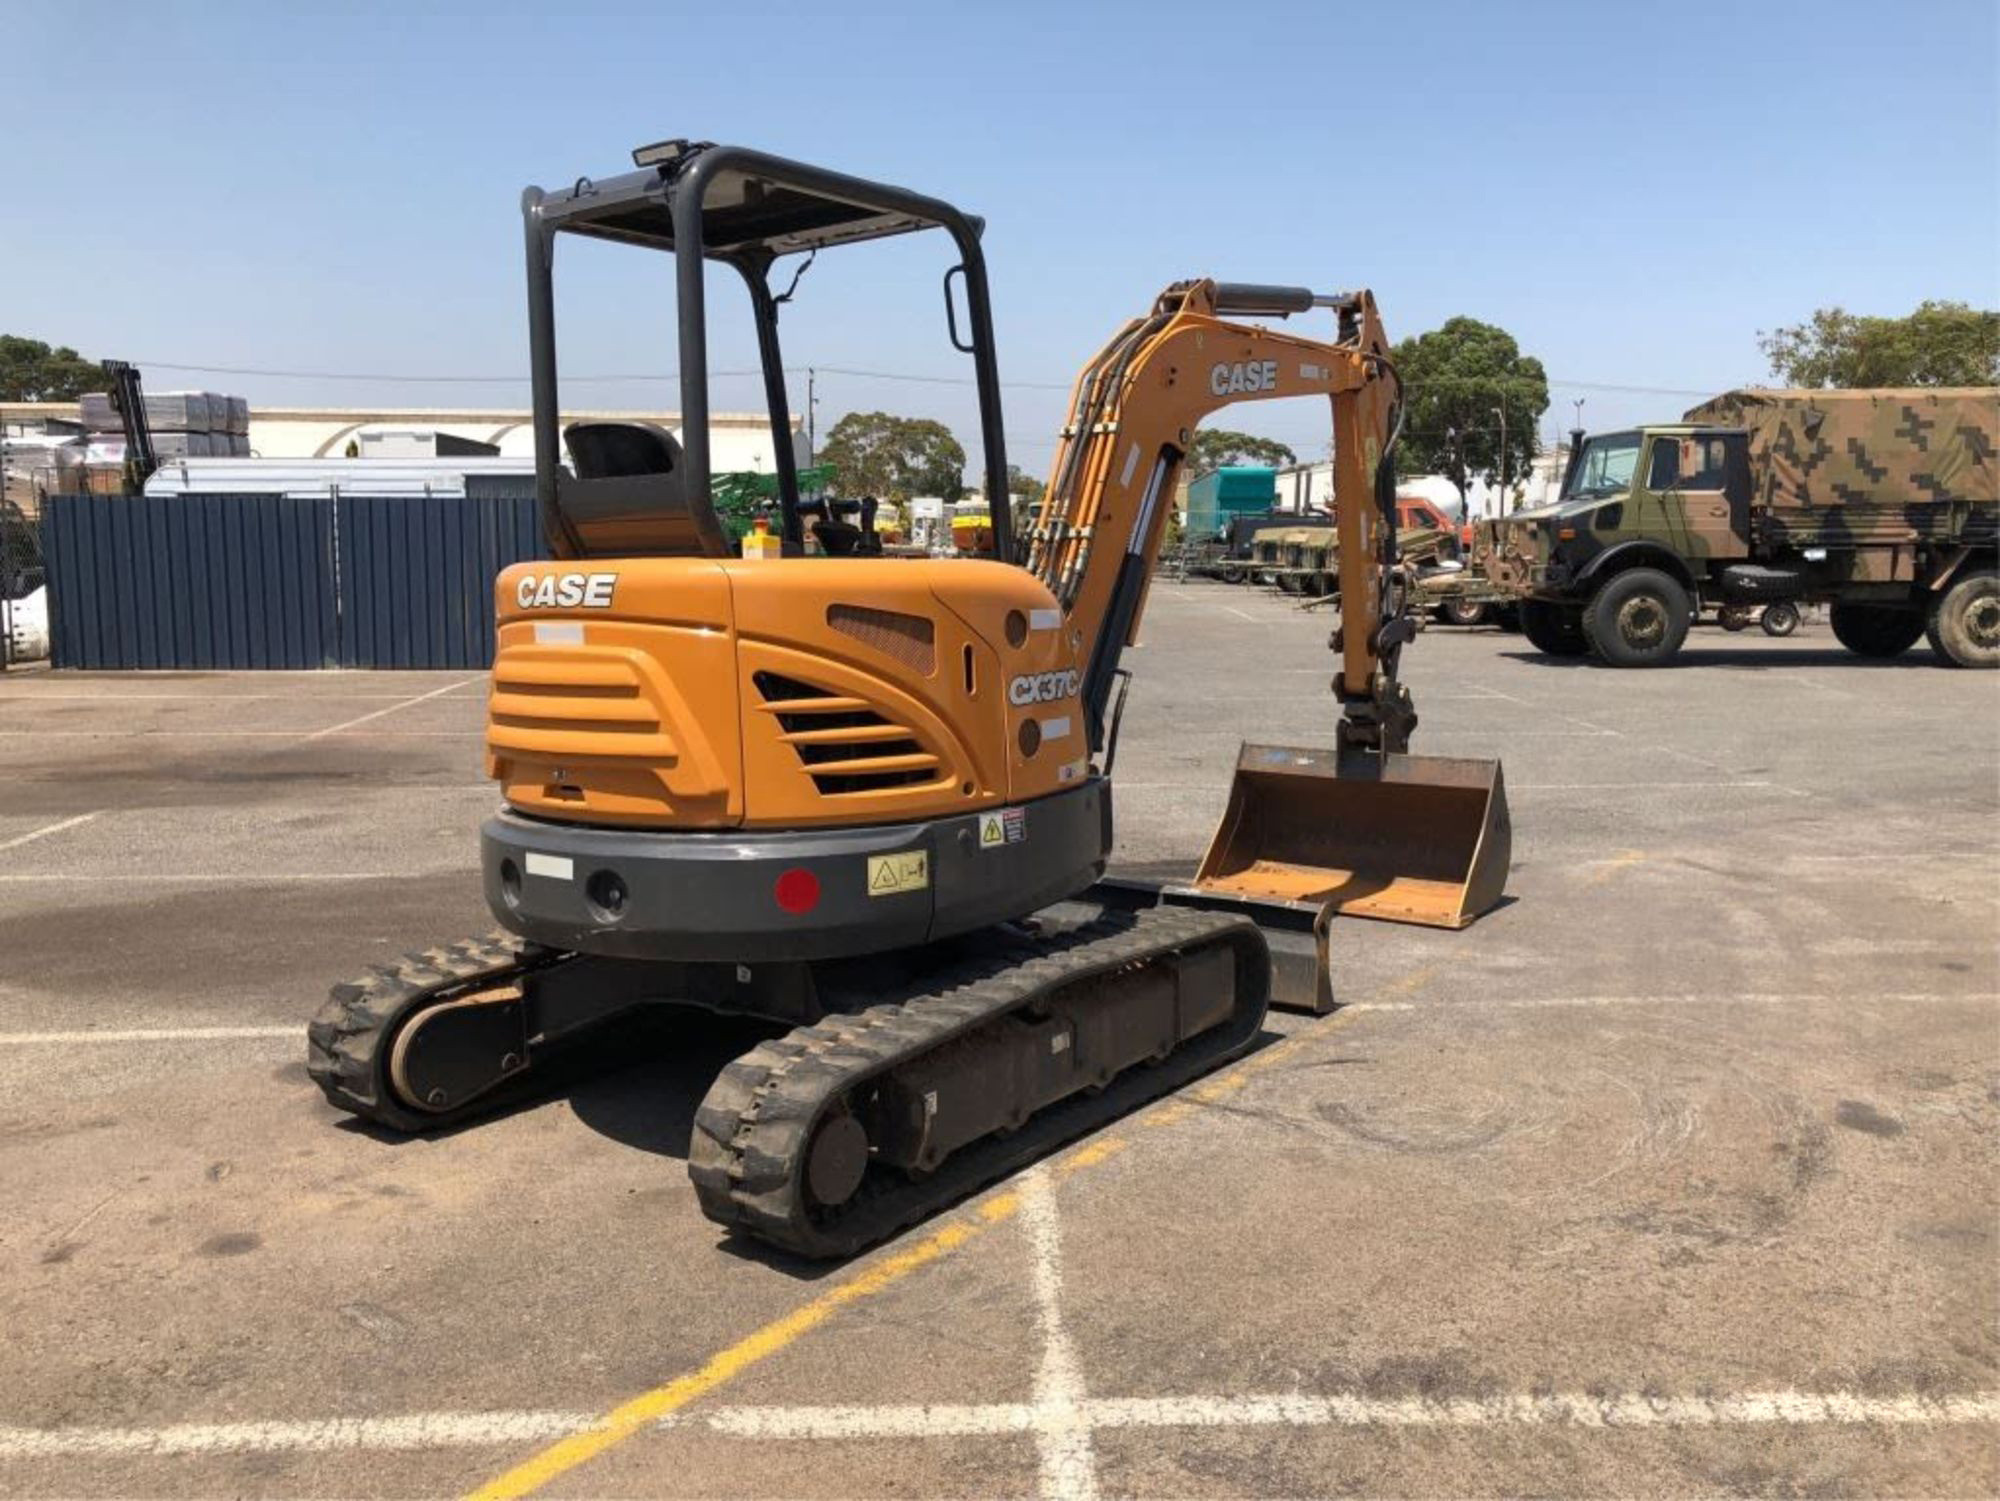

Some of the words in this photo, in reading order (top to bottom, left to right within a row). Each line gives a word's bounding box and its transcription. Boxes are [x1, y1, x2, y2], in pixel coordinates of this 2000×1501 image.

[1211, 360, 1277, 394] CASE
[517, 573, 618, 609] CASE
[1009, 669, 1078, 705] CX37C
